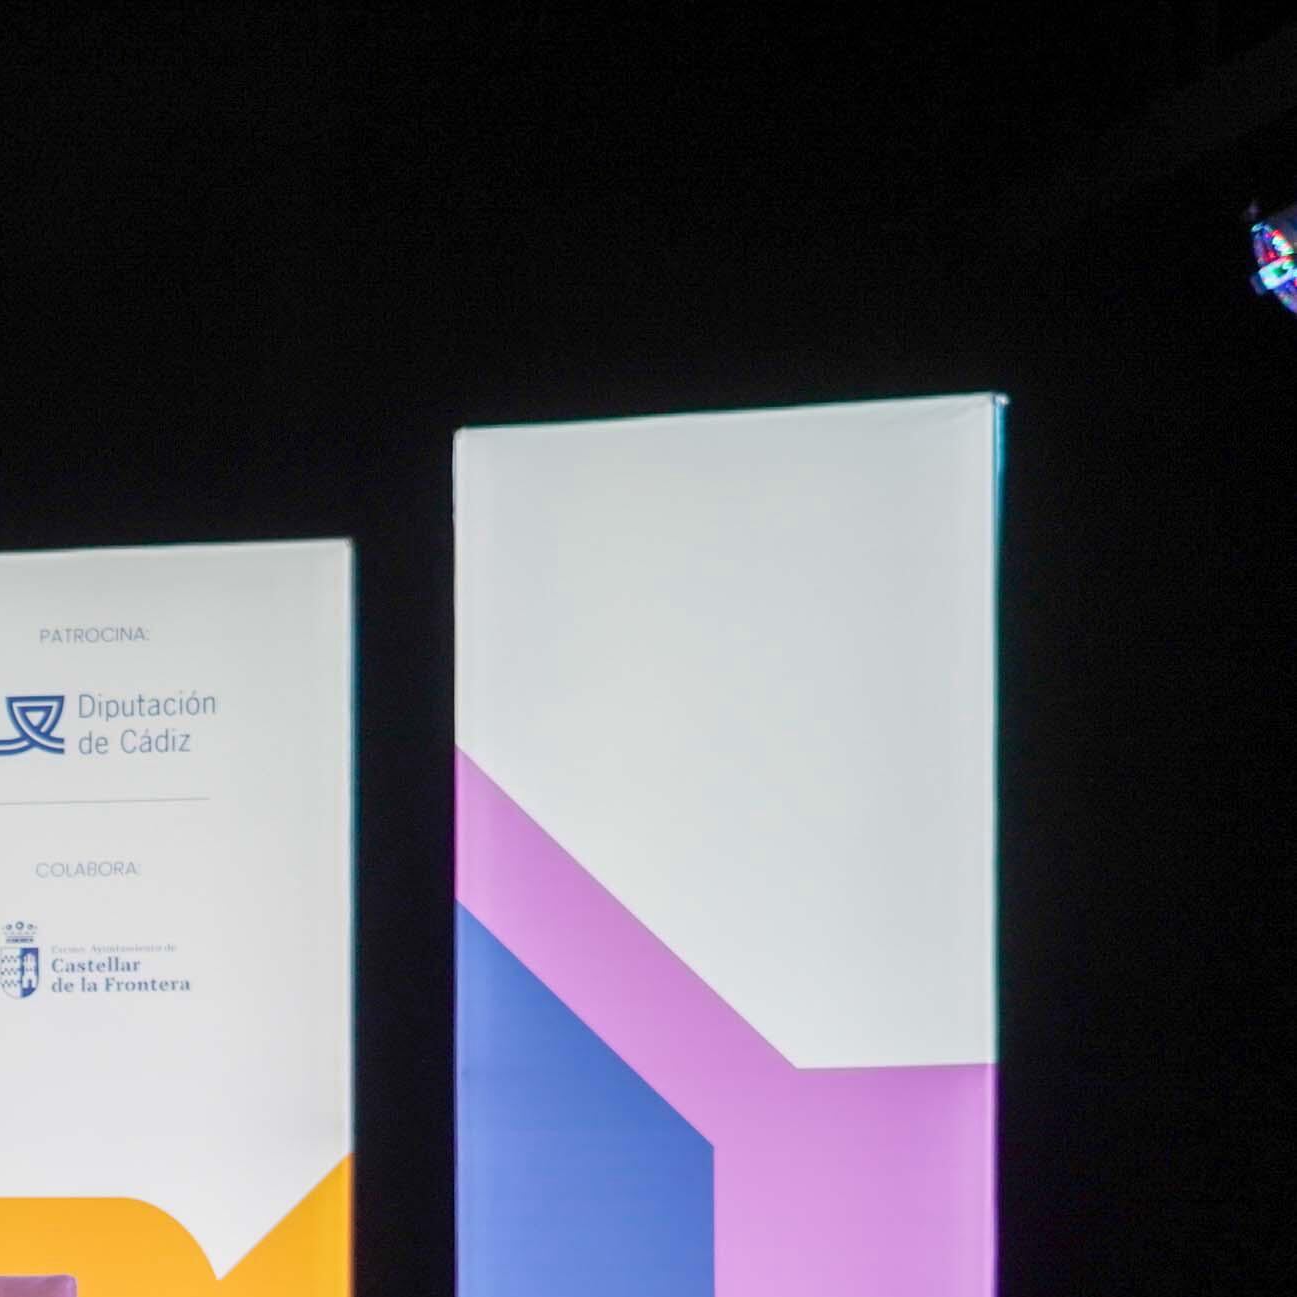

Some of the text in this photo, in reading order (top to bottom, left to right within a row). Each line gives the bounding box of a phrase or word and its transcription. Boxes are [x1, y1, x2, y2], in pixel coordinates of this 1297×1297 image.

[39, 626, 150, 643] PATROCINA:
[78, 690, 217, 721] Diputación
[78, 728, 192, 755] de Cádiz
[35, 861, 143, 879] COLABORA:
[51, 956, 141, 973] Castellar
[51, 976, 191, 993] de la Frontera
